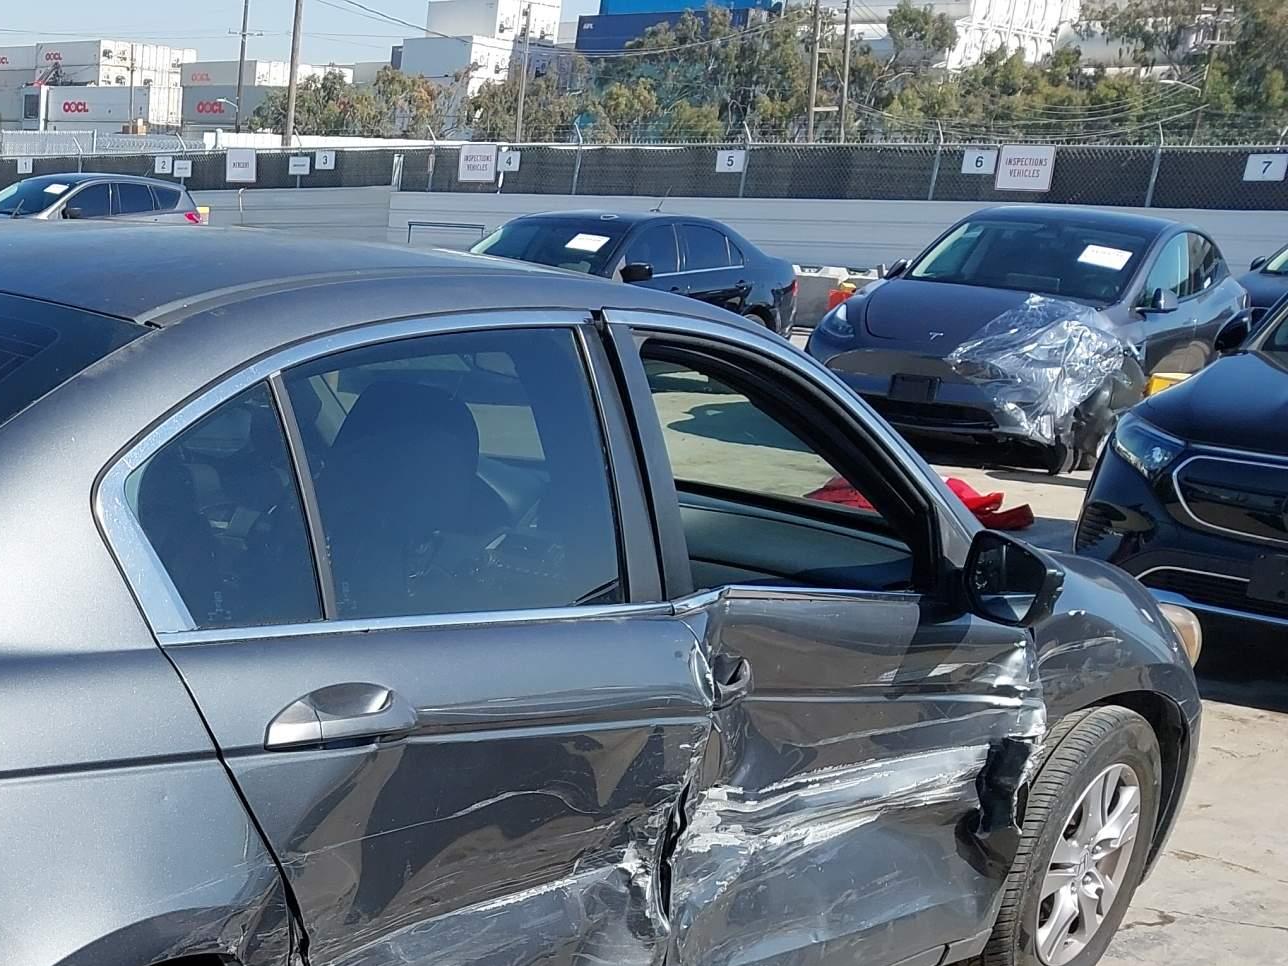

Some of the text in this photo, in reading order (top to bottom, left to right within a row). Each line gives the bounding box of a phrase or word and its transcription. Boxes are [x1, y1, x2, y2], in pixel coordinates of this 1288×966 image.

[45, 52, 62, 61] OOCL
[63, 101, 88, 113] OOCL
[197, 101, 224, 114] OOCL
[161, 160, 166, 169] 2
[322, 155, 328, 165] 3
[505, 156, 512, 166] 4
[727, 155, 734, 167] 5
[975, 155, 984, 168] 6
[1005, 157, 1048, 167] INSPECTIONS
[1262, 161, 1273, 174] 7
[1009, 169, 1040, 178] VEHICLES
